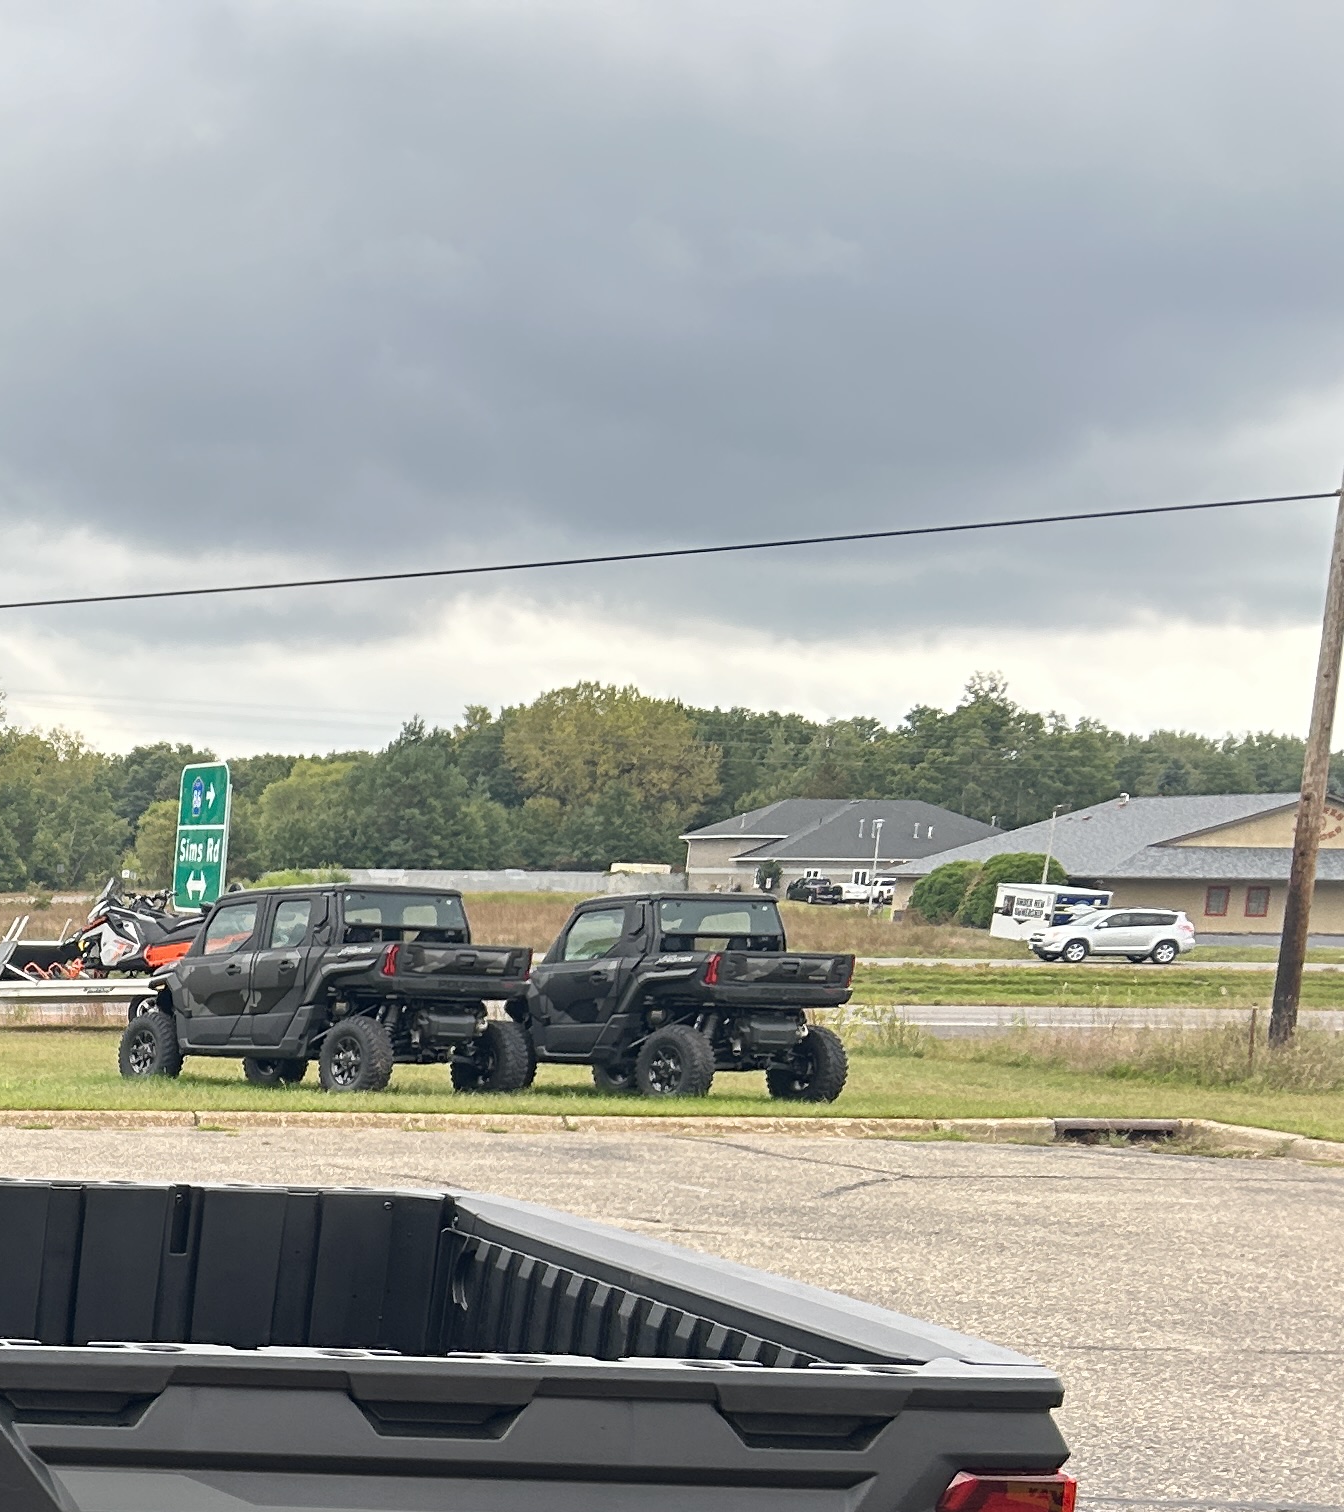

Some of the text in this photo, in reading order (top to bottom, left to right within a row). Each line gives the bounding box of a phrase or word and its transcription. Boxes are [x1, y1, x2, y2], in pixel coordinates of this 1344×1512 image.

[179, 837, 221, 863] Sims Rd
[1033, 899, 1046, 909] NEW
